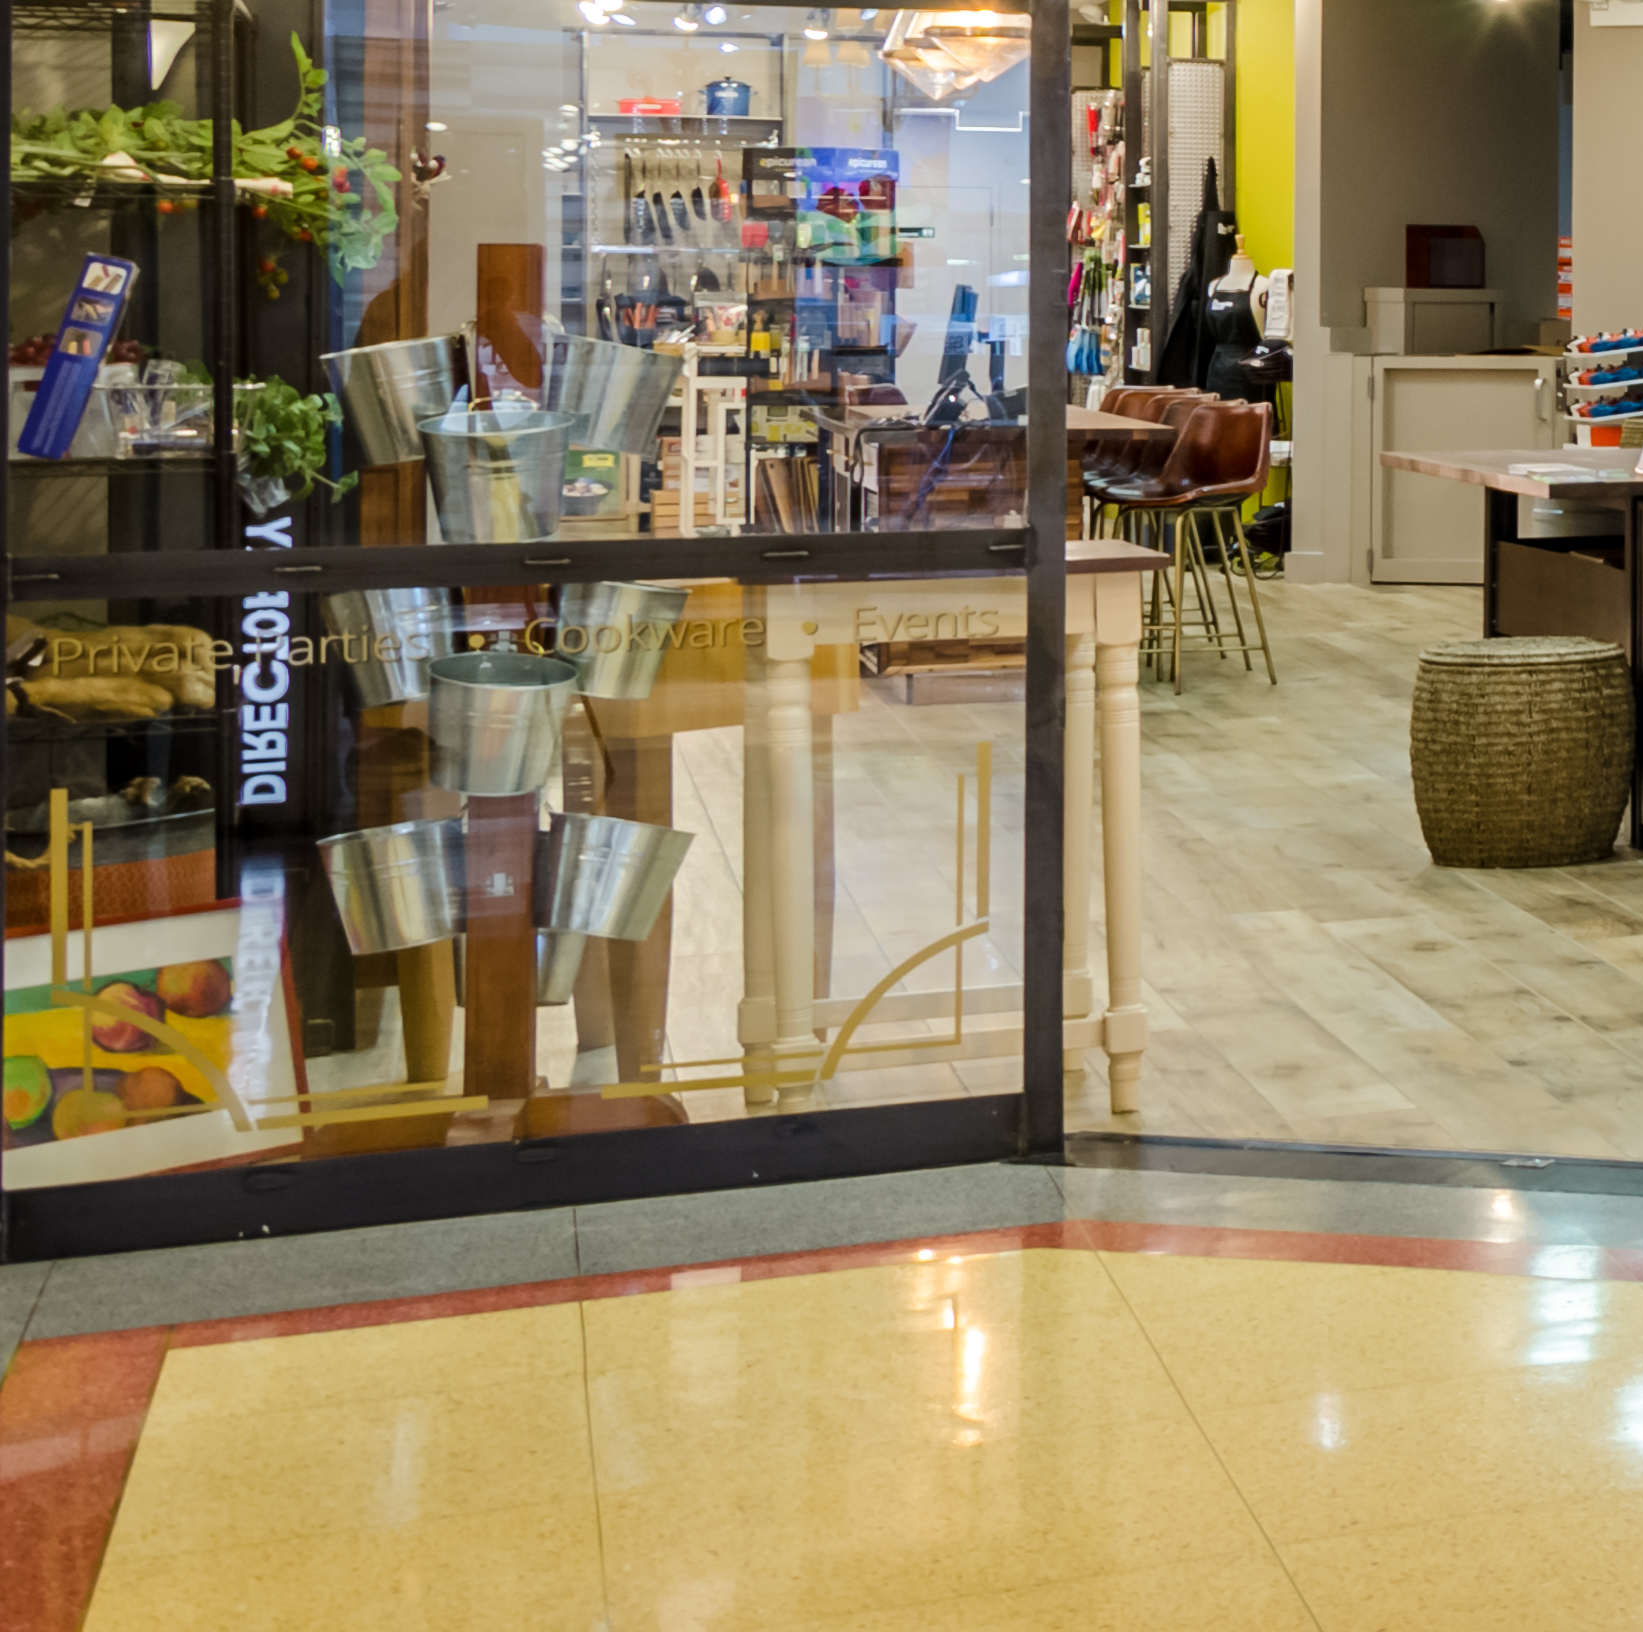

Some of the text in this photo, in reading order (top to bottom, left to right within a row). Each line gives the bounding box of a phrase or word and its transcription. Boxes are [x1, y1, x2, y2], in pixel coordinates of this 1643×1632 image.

[52, 606, 1000, 676] Private Parties Cookware Events
